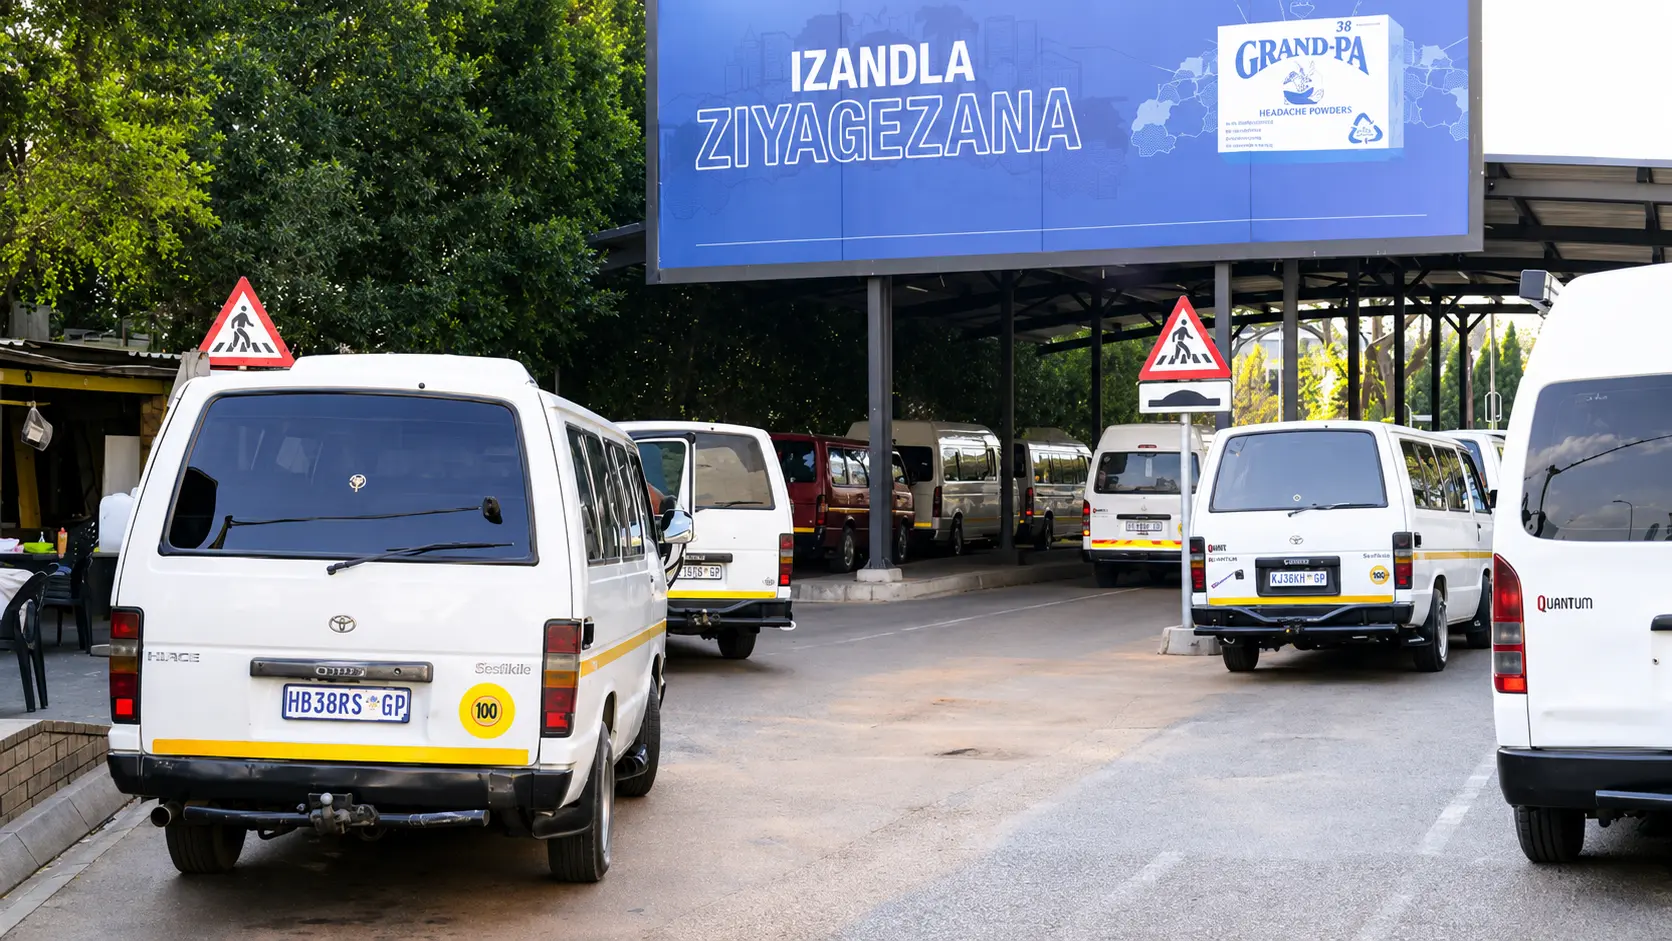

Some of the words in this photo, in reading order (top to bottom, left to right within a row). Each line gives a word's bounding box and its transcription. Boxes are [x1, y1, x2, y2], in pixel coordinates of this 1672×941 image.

[1336, 20, 1352, 33] 38
[791, 40, 976, 92] IZANDLA
[1235, 35, 1369, 80] GRAND-PA
[1259, 107, 1307, 118] HEADACHE
[1309, 105, 1353, 116] POWDERS
[695, 87, 1082, 171] ZIYAGEZANA
[1271, 573, 1305, 584] KJ36KH
[1313, 573, 1326, 584] GP
[1537, 594, 1593, 613] QUANTUM
[147, 651, 200, 663] HIACE
[475, 662, 532, 675] Sesfikile
[288, 690, 363, 716] HB38RS
[382, 693, 406, 717] GP
[475, 702, 498, 720] 100
